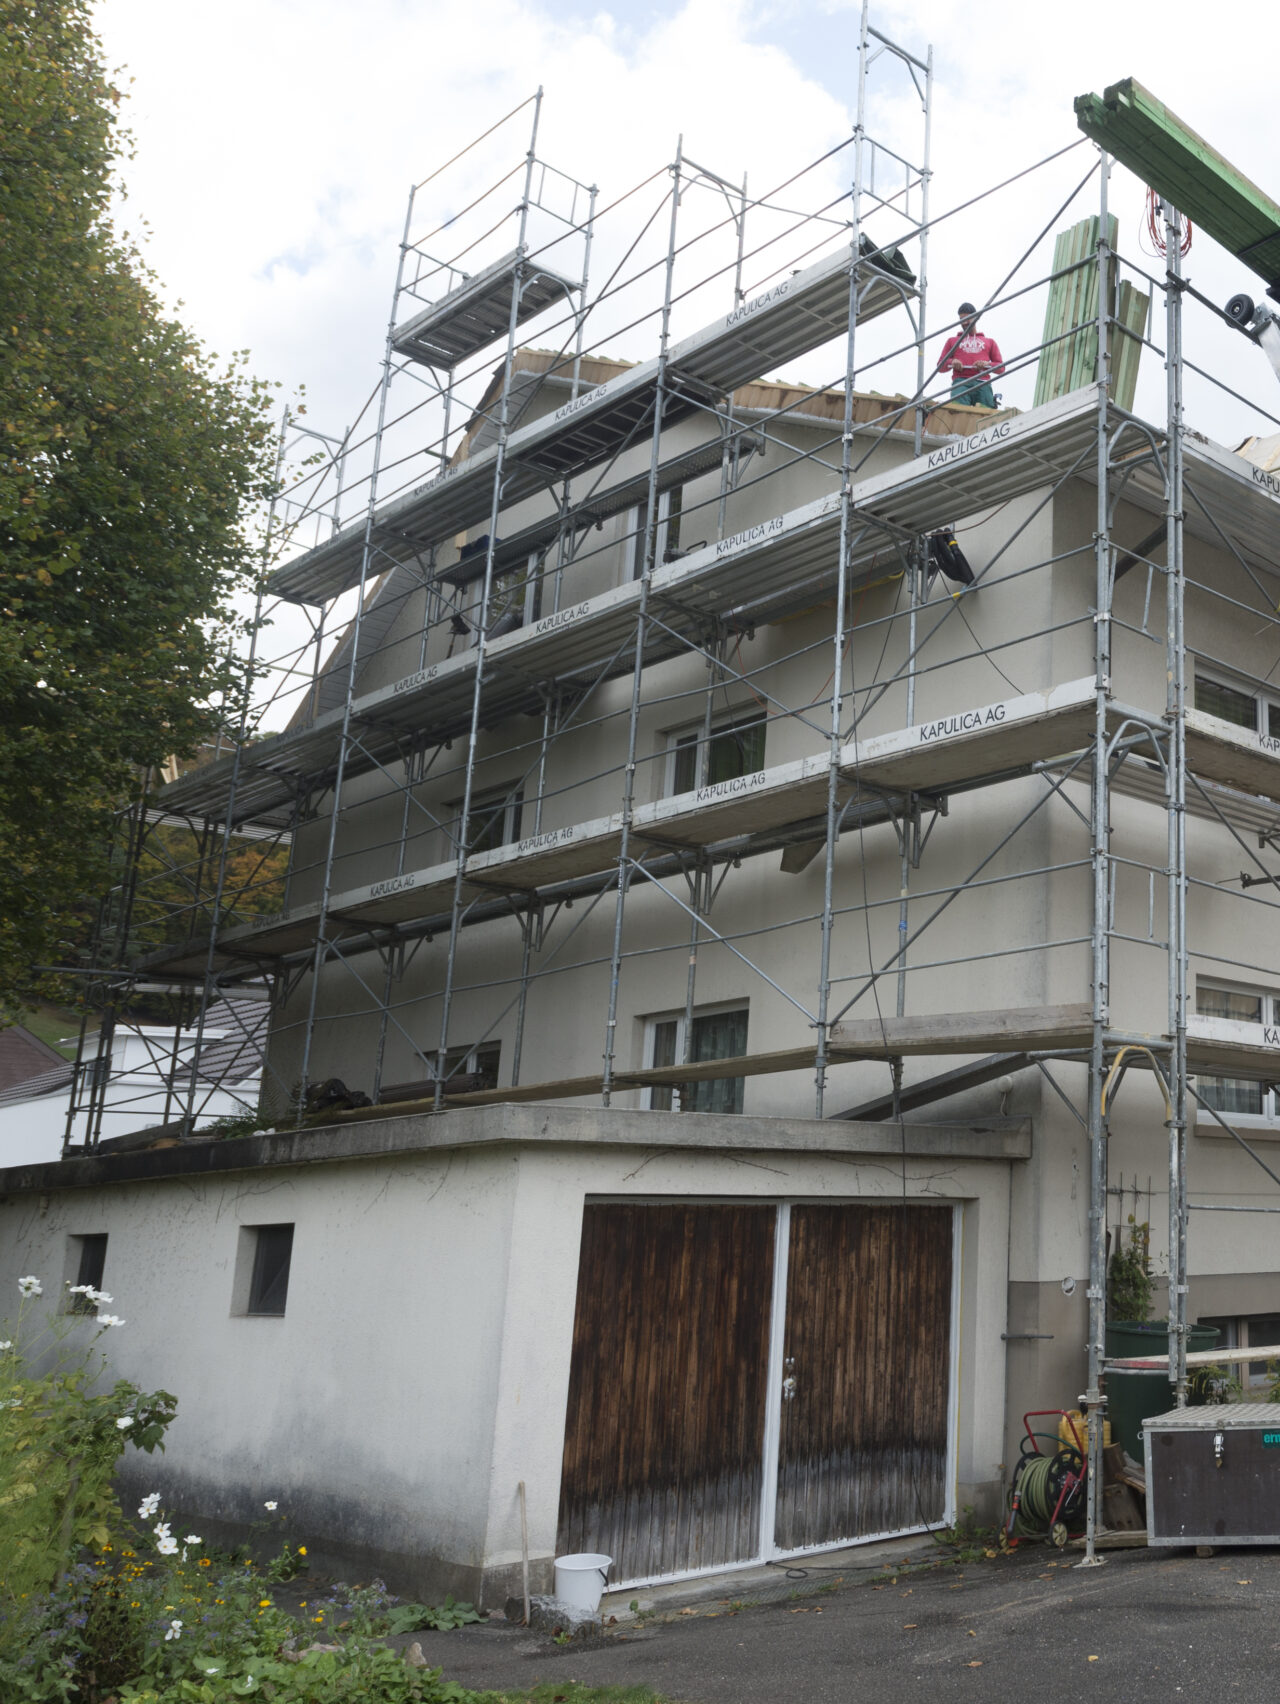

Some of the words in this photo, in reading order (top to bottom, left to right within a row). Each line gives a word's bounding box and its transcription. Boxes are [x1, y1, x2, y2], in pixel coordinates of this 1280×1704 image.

[725, 293, 771, 327] KAPULICA
[773, 281, 788, 299] AG
[554, 393, 593, 421] KAPULICA
[594, 384, 608, 400] AG
[928, 433, 987, 468] KAPULICA
[991, 422, 1011, 441] AG
[716, 524, 765, 554] KAPULICA
[768, 514, 784, 532] AG
[535, 608, 575, 634] KAPULICA
[577, 602, 590, 617] AG
[393, 671, 426, 694] KAPULICA
[427, 665, 438, 680] AG
[920, 711, 982, 742] KAPULICA
[984, 704, 1005, 724] AG
[696, 777, 747, 803] KAPULICA
[749, 771, 766, 788] AG
[517, 831, 559, 853] KAPULICA
[560, 826, 574, 840] AG
[370, 878, 402, 898] KAPULICA
[403, 874, 415, 888] AG
